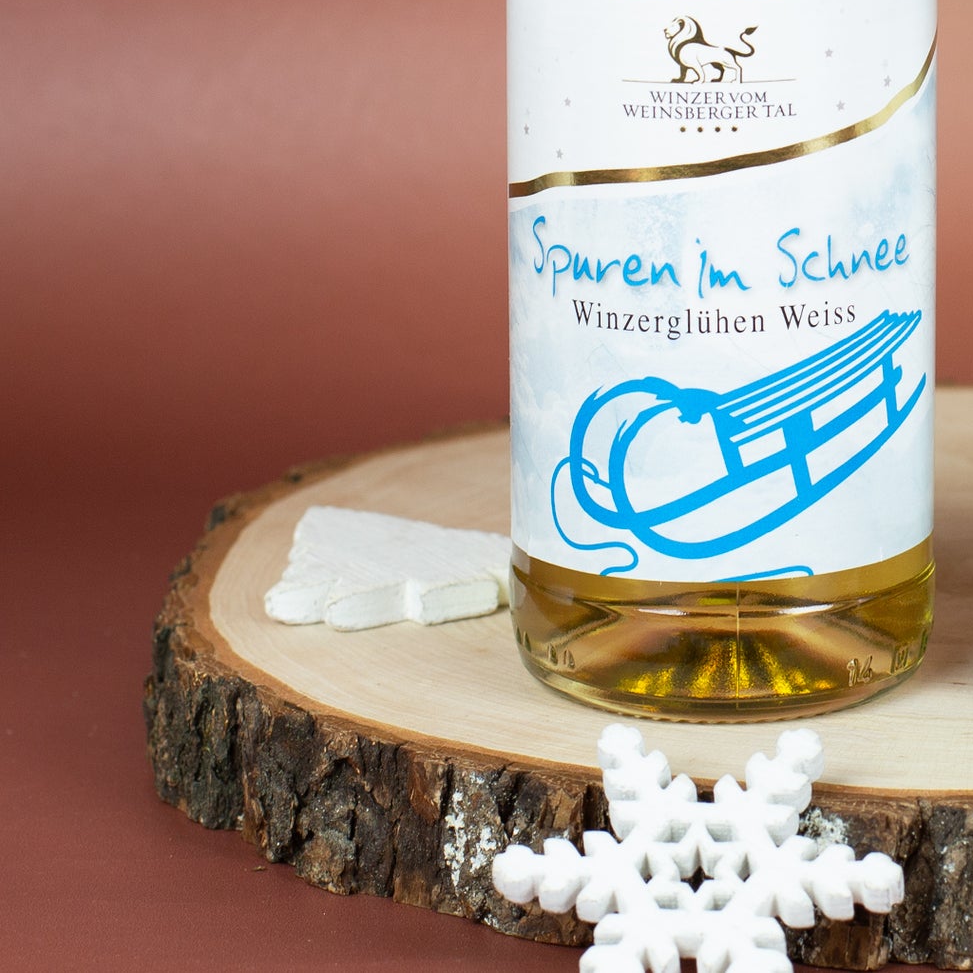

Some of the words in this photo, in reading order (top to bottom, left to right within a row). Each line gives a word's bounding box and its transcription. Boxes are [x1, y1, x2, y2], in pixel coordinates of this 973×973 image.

[622, 104, 758, 120] WEINSBERGER
[762, 103, 798, 118] TAL
[650, 90, 727, 105] WINZER
[729, 91, 767, 103] VOM
[532, 215, 682, 298] Spuren
[695, 237, 751, 299] im
[776, 227, 910, 289] Schnee
[572, 299, 765, 341] Winzerglühen
[779, 300, 857, 330] Weiss
